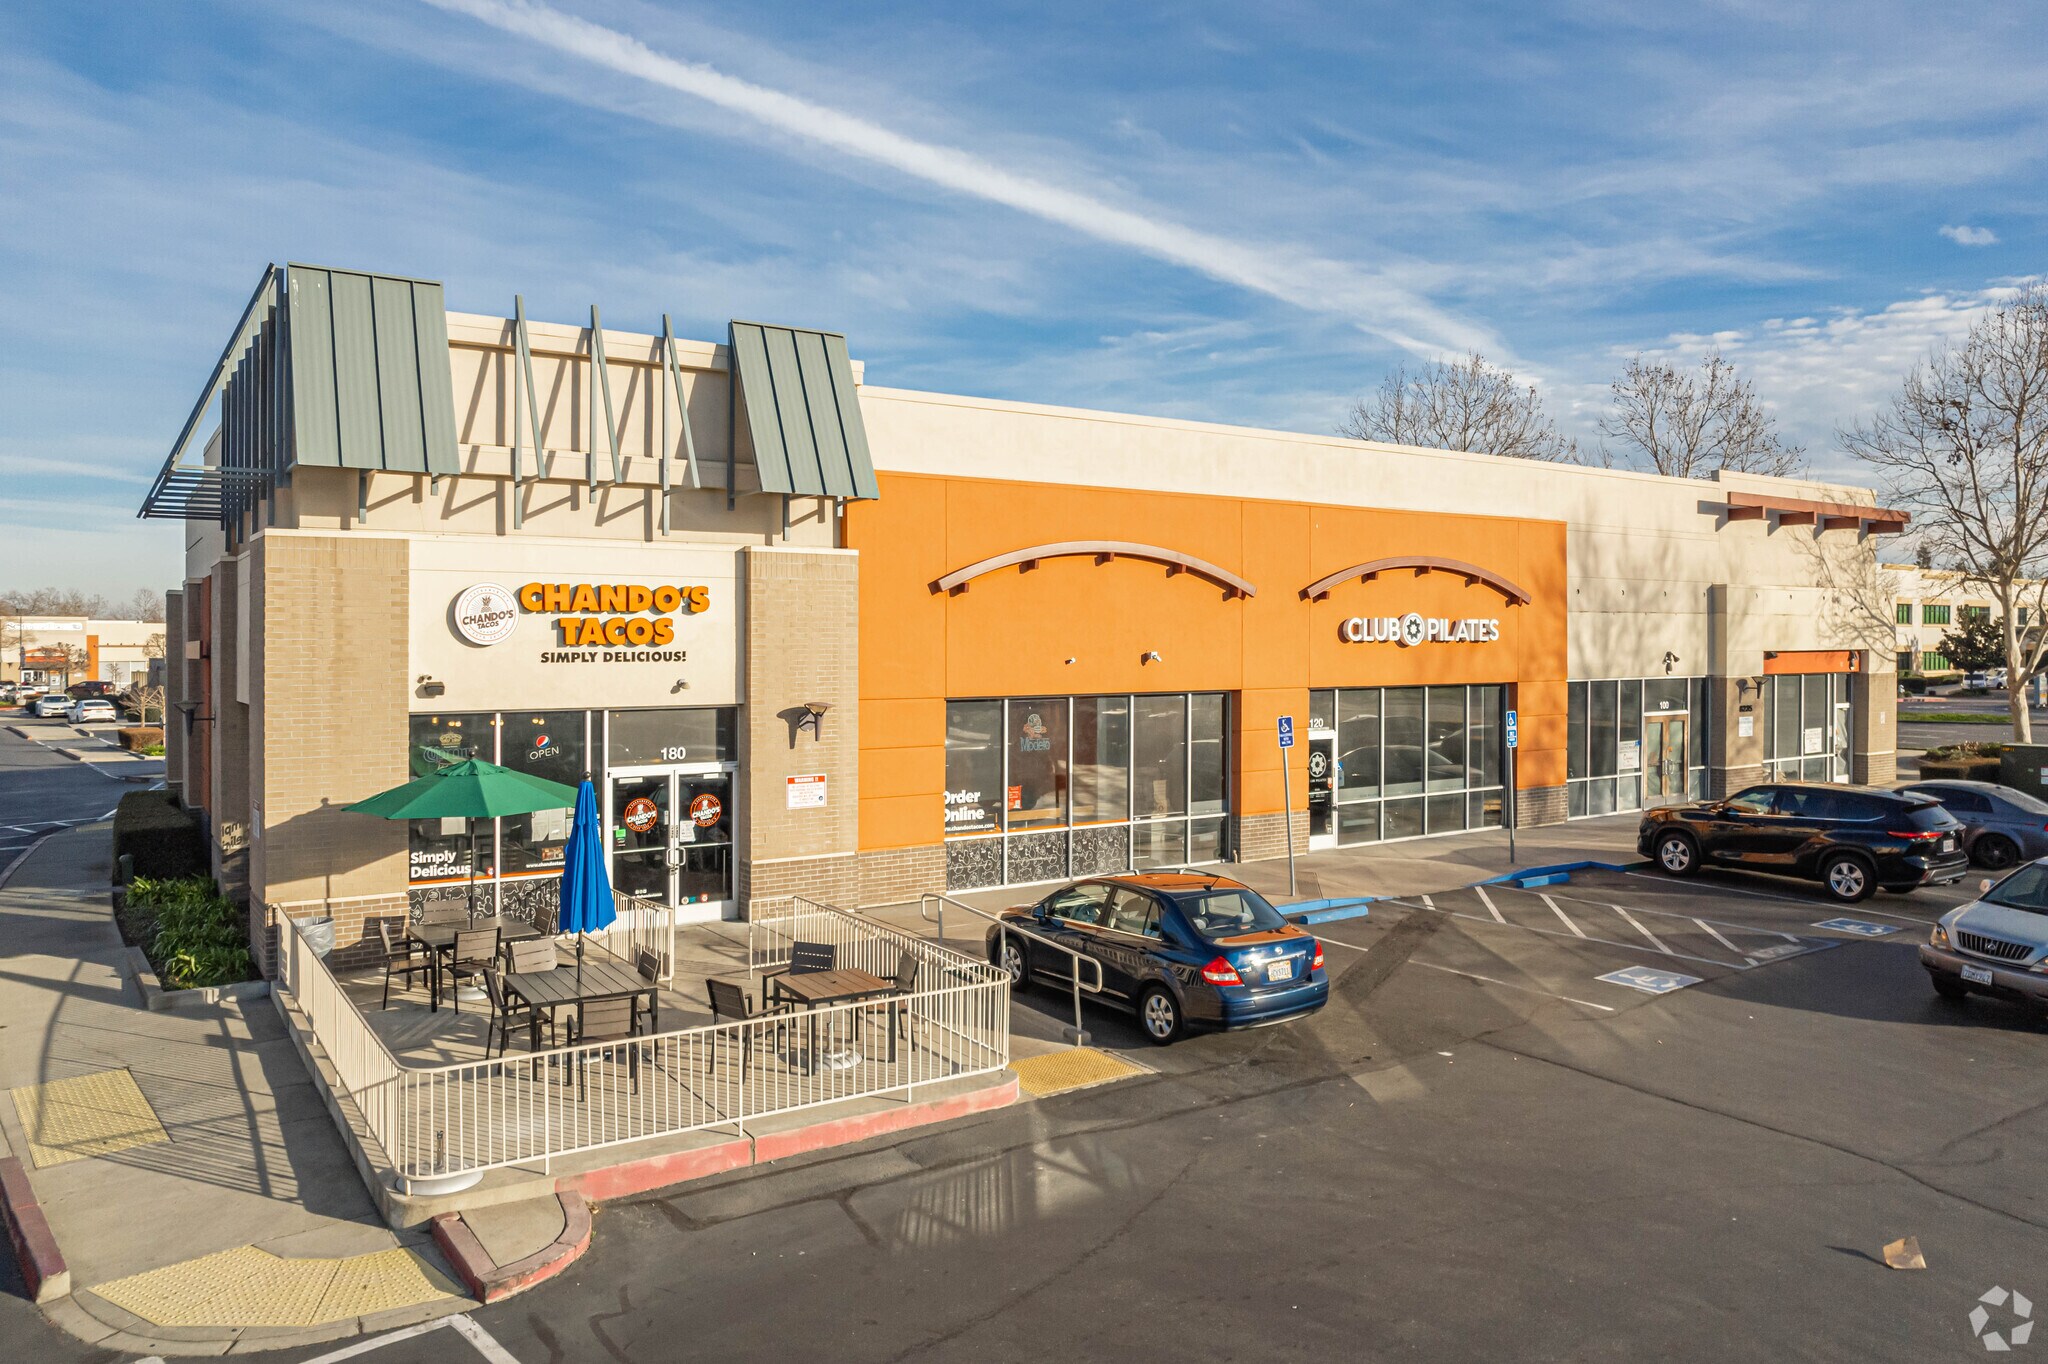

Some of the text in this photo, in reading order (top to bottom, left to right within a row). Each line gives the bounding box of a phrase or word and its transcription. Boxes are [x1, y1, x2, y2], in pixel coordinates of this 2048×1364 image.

[520, 582, 711, 613] CHANDO'S
[462, 609, 514, 626] CHANDO'S
[477, 620, 500, 629] TACOS
[559, 617, 675, 645] TACOS
[1347, 617, 1500, 642] CLUB PILATES
[540, 651, 687, 664] SIMPLY DELICIOUS!
[1659, 700, 1670, 710] 100
[1309, 718, 1324, 728] 120
[529, 746, 560, 760] OPEN
[660, 747, 686, 761] 180
[943, 790, 981, 804] Order
[944, 806, 985, 822] Online
[410, 850, 457, 864] Simply
[410, 864, 472, 878] Delicious
